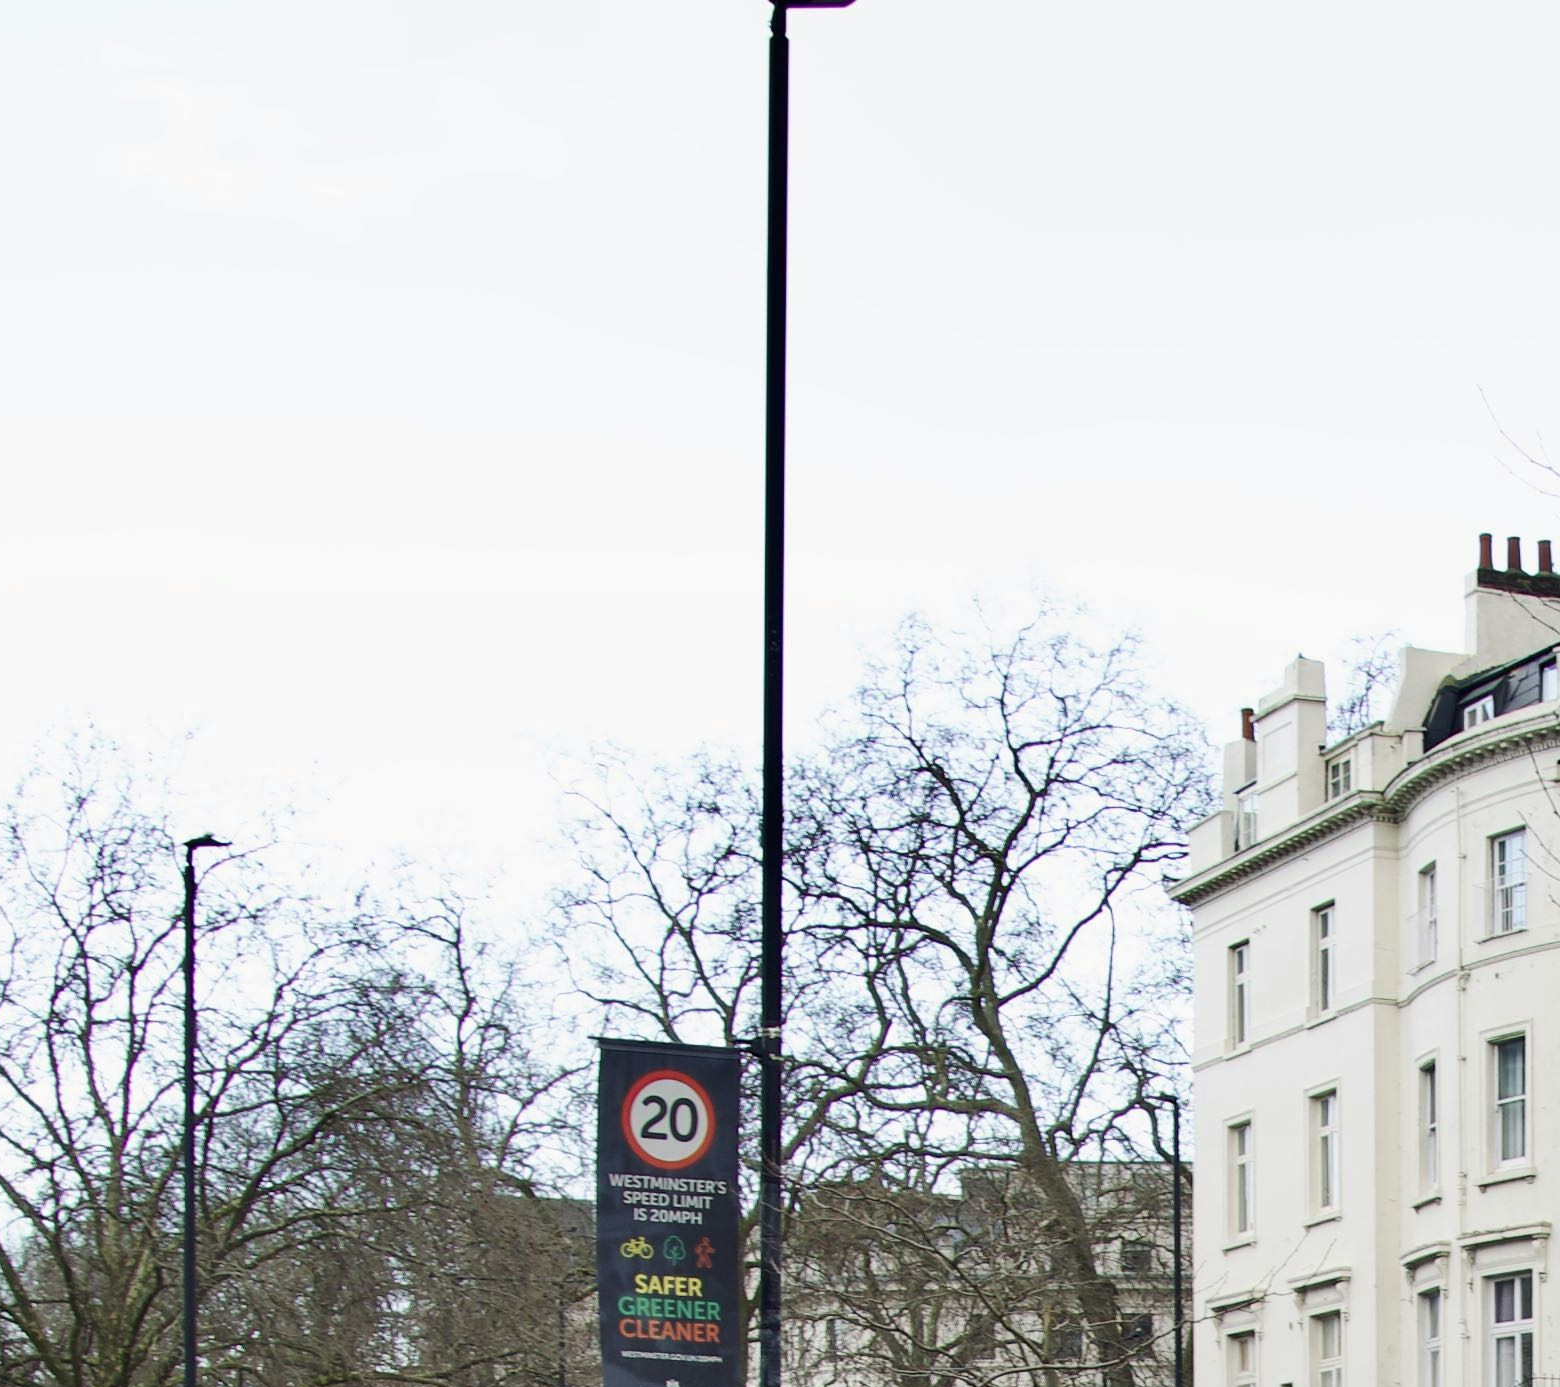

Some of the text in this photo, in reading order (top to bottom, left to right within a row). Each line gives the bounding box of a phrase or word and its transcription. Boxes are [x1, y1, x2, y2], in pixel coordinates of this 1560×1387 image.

[640, 1095, 699, 1142] 20
[608, 1173, 728, 1195] WESTMINSTER'S
[623, 1190, 714, 1209] SPEED LIMIT
[633, 1207, 703, 1224] IS 20MPH
[634, 1273, 704, 1297] SAFER
[617, 1296, 721, 1321] GREENER
[618, 1318, 721, 1343] CLEANER
